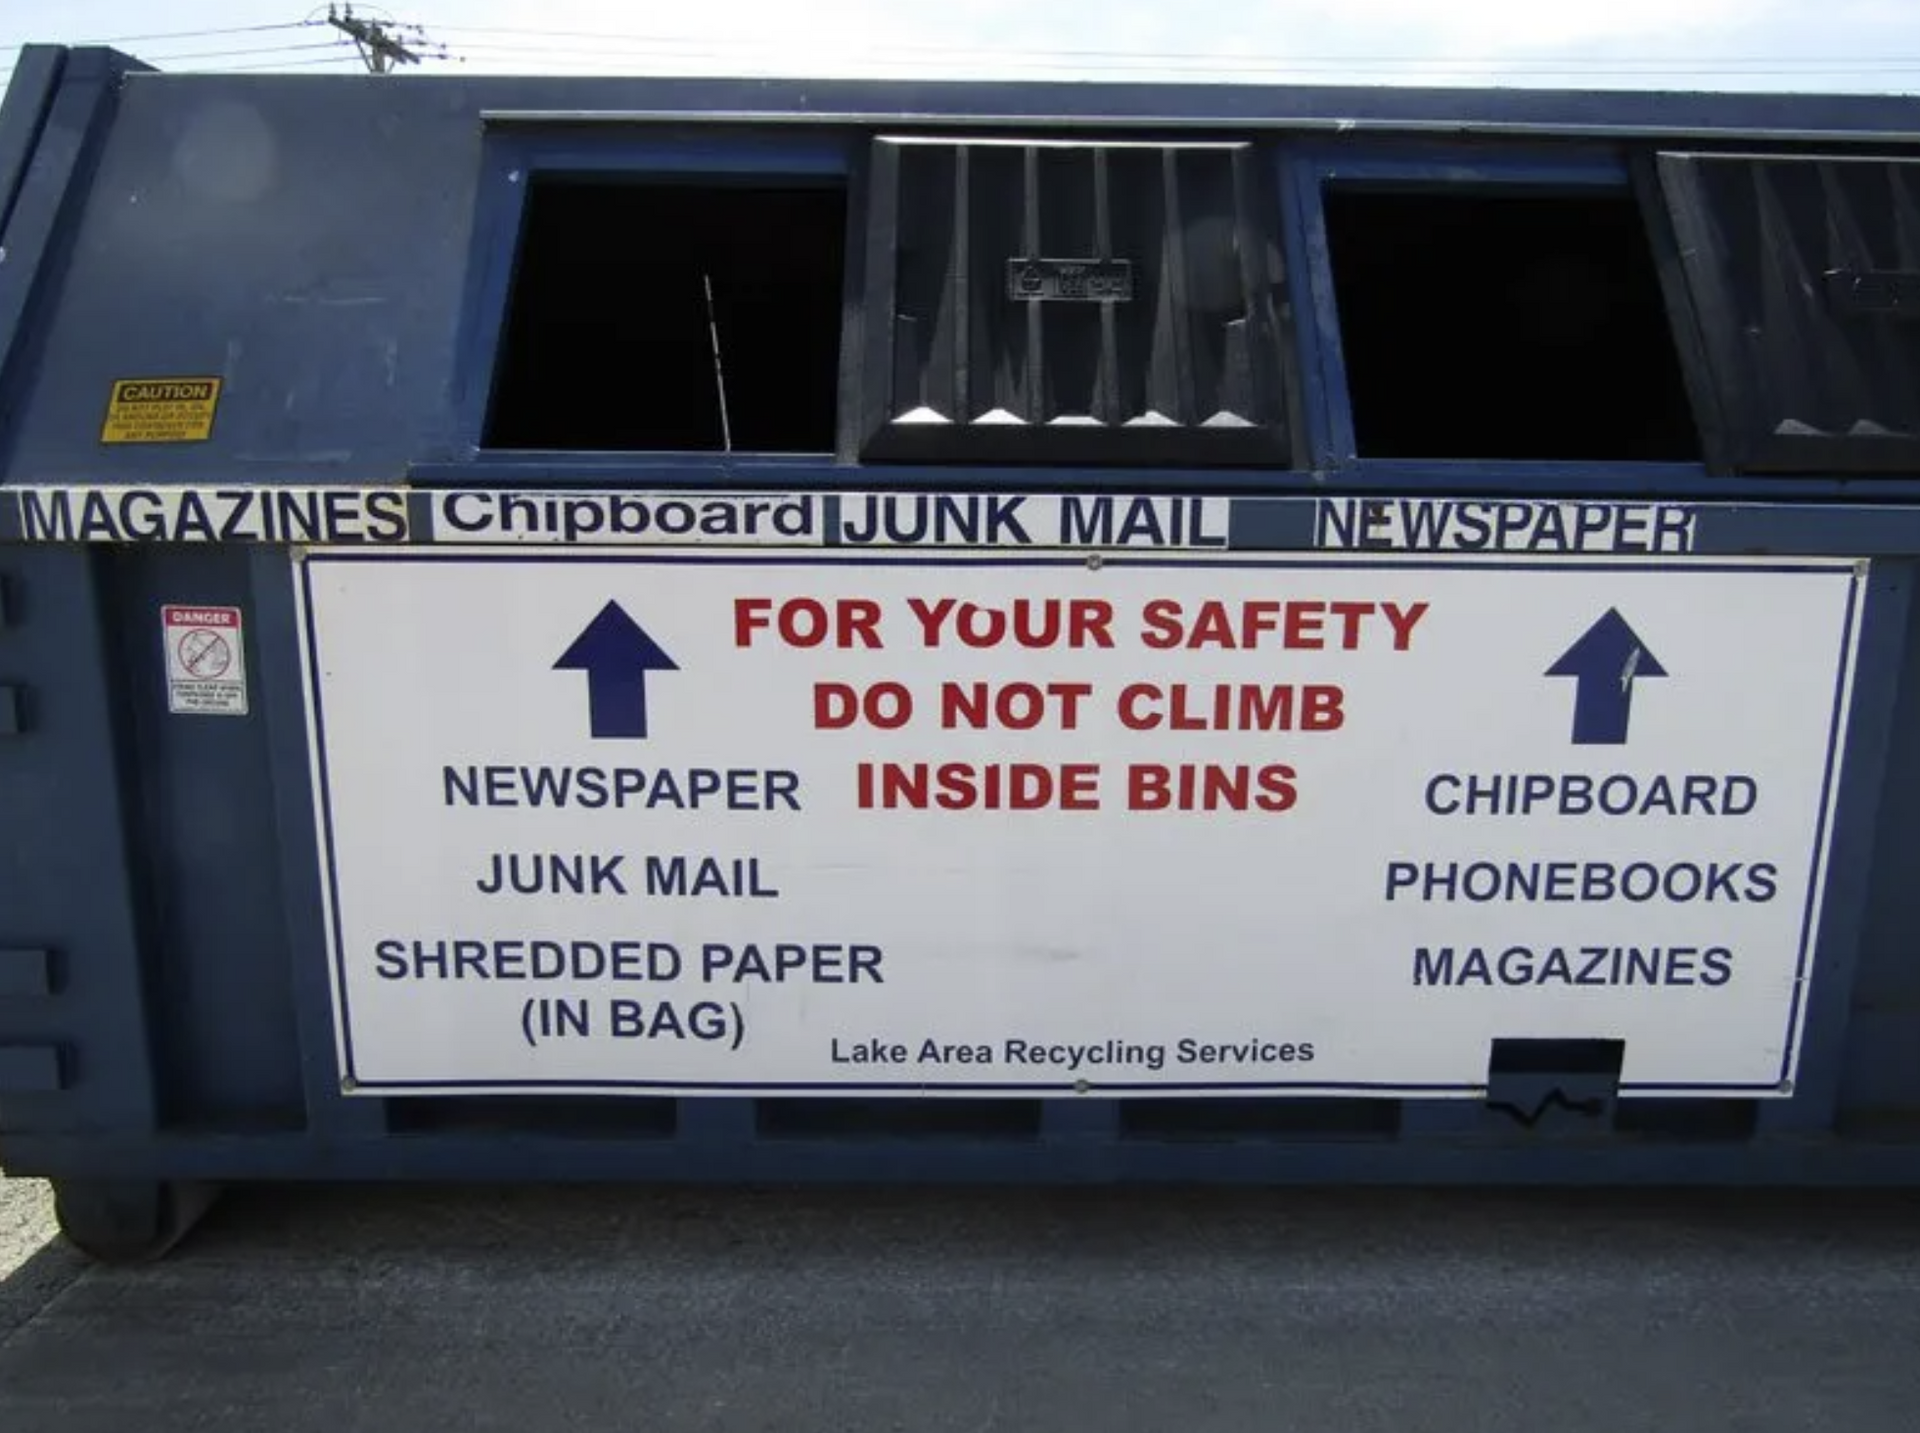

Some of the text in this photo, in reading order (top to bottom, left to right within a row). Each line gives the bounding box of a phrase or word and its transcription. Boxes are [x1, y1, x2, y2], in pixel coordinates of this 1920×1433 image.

[124, 384, 208, 401] CAUTION
[21, 490, 408, 541] MAGAZINES
[443, 492, 813, 541] Chipboard
[843, 495, 1227, 547] JUNK MAIL
[1317, 498, 1693, 552] NEWSPAPER
[172, 611, 231, 624] DANGER
[734, 597, 1430, 651] FOR YOUR SAFETY
[813, 681, 1345, 732] DO NOT CLIMB
[442, 765, 802, 811] NEWSPAPER
[857, 762, 1298, 812] INSIDE BINS
[1425, 773, 1758, 816] CHIPBOARD
[476, 853, 780, 898] JUNK MAIL
[1385, 861, 1778, 903] PHONEBOOKS
[374, 939, 885, 984] SHREDDED PAPER
[1413, 945, 1733, 987] MAGAZINES
[521, 997, 745, 1052] (IN BAG)
[831, 1037, 1315, 1072] Lake Area Recycling Services
